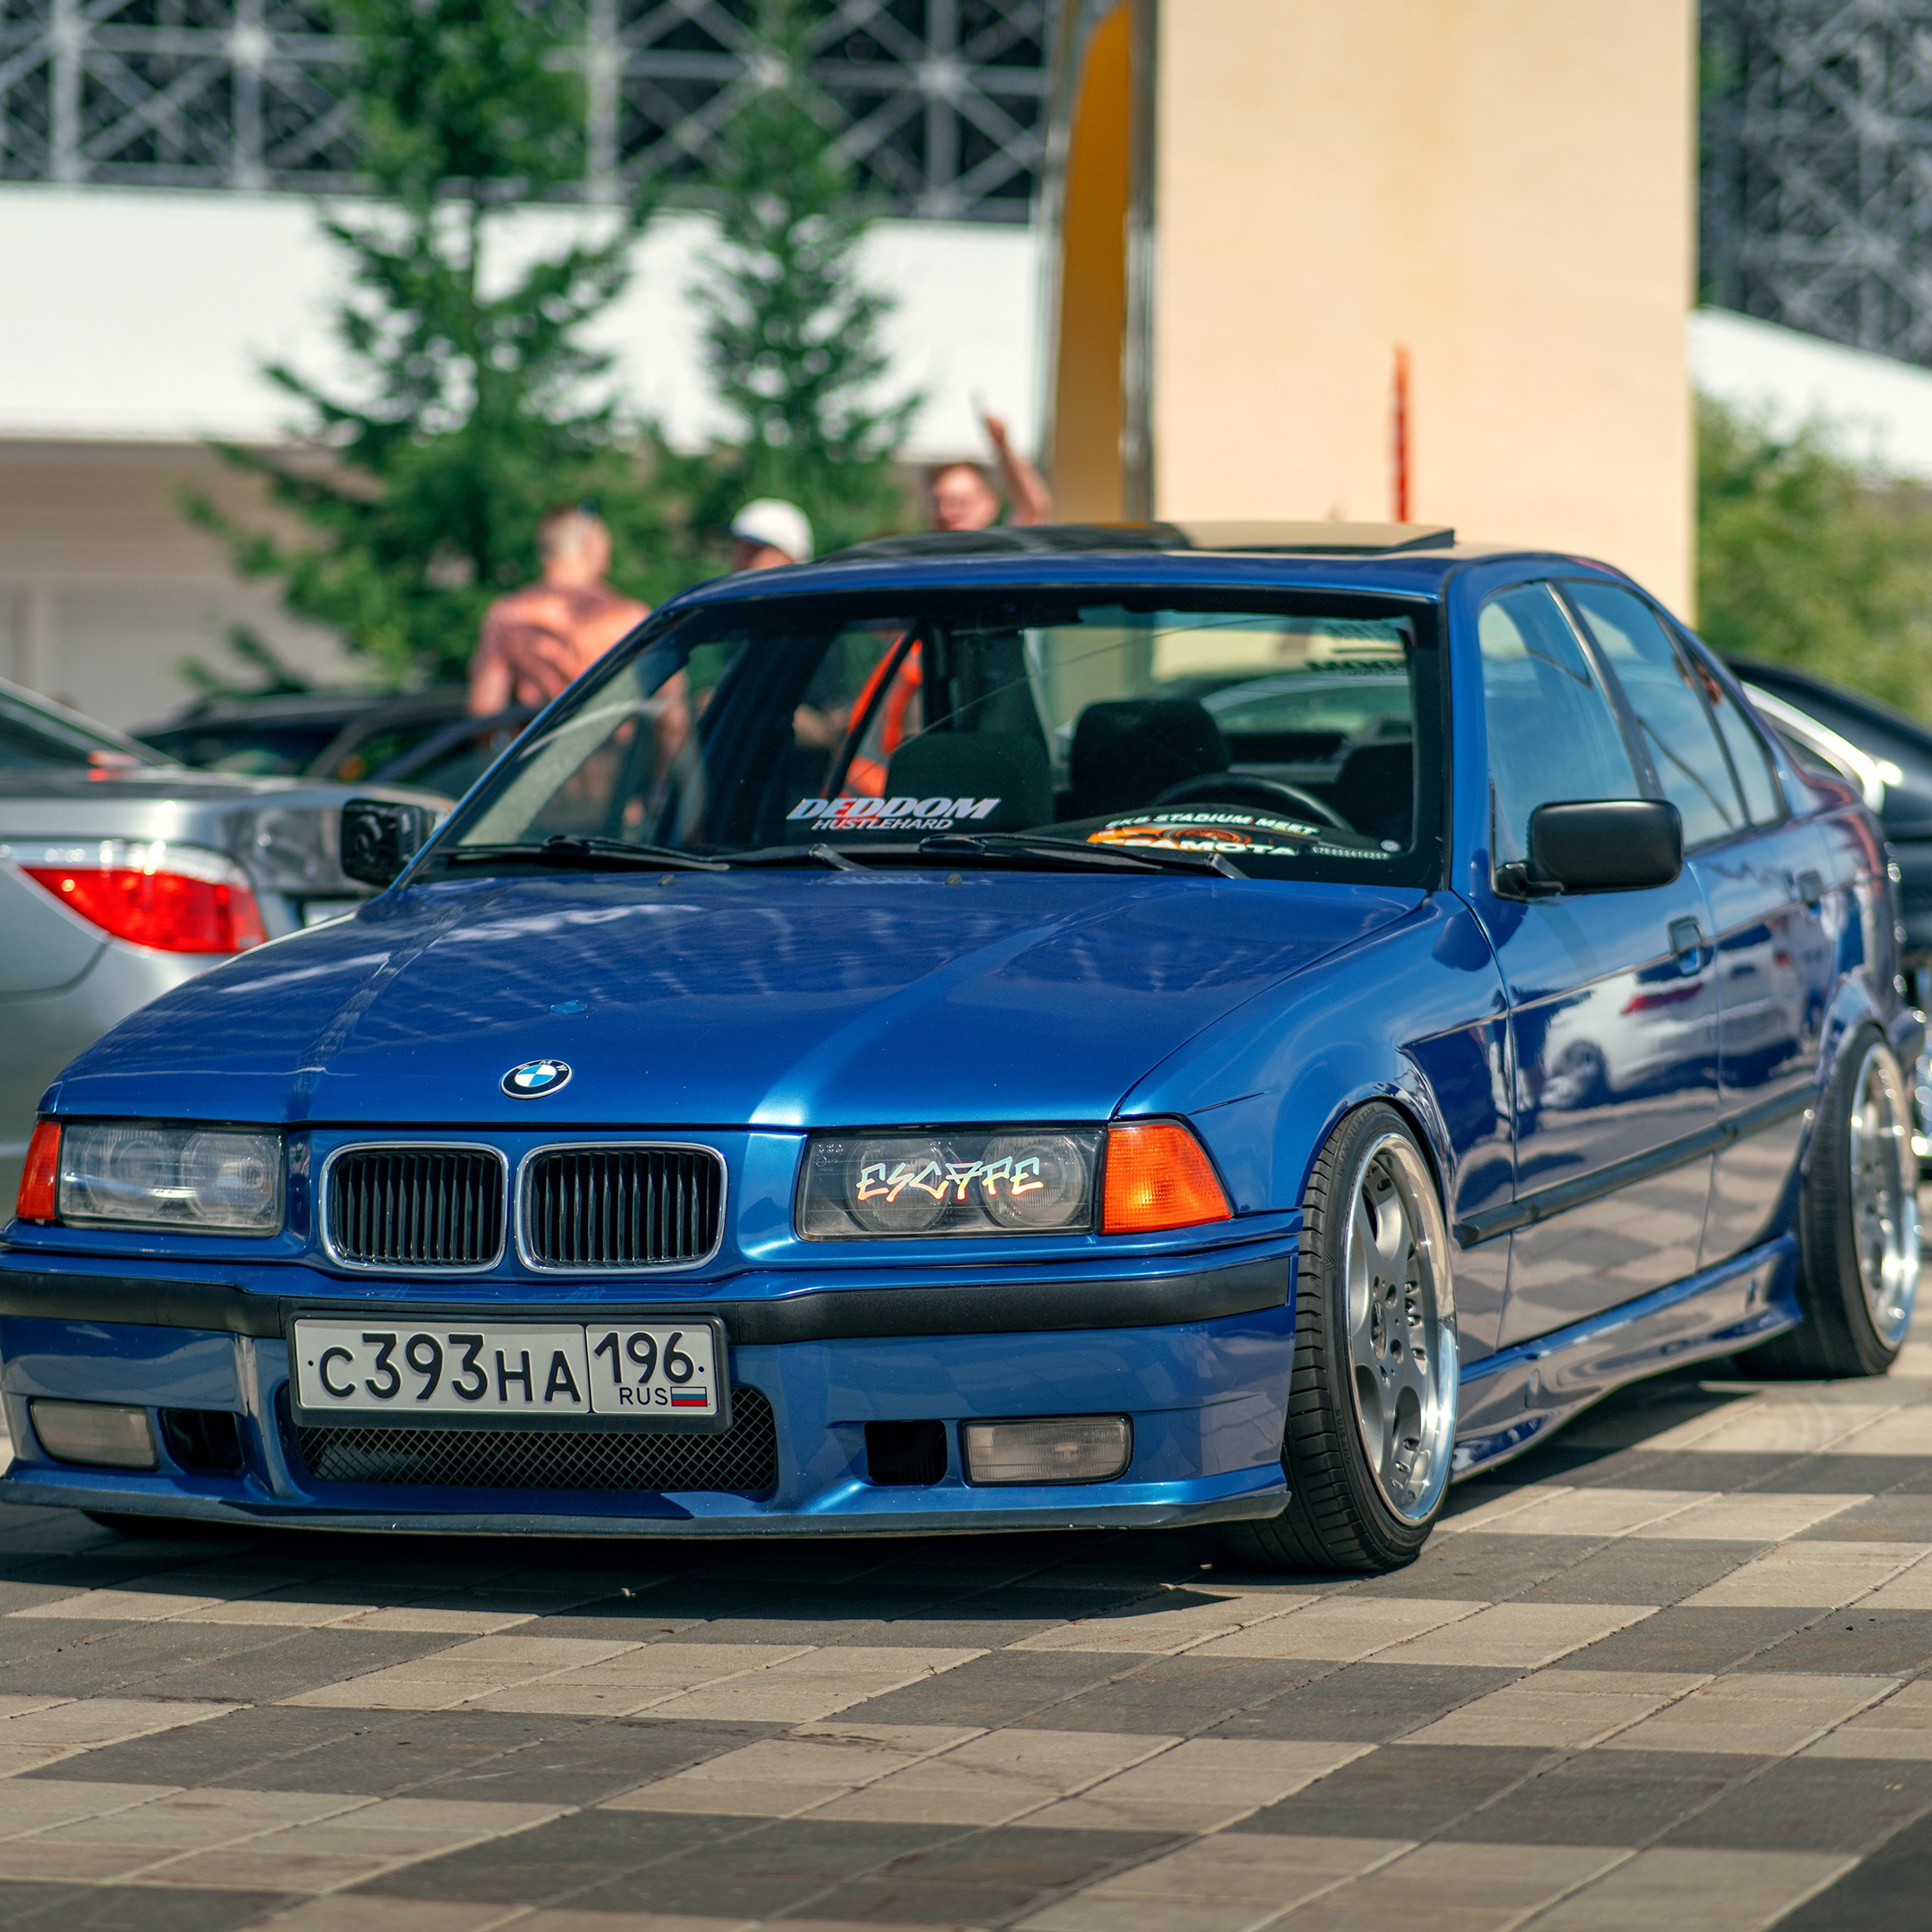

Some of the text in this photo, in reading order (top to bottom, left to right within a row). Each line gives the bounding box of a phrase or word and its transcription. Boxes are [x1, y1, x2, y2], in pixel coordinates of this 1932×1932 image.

[786, 797, 1001, 820] DEDDOM
[811, 818, 955, 830] HUSTLEHARD
[1152, 812, 1254, 826] STADIUM
[1254, 817, 1320, 836] MEET
[517, 1059, 568, 1072] BMW
[593, 1331, 695, 1384] 196
[618, 1386, 669, 1406] RUS
